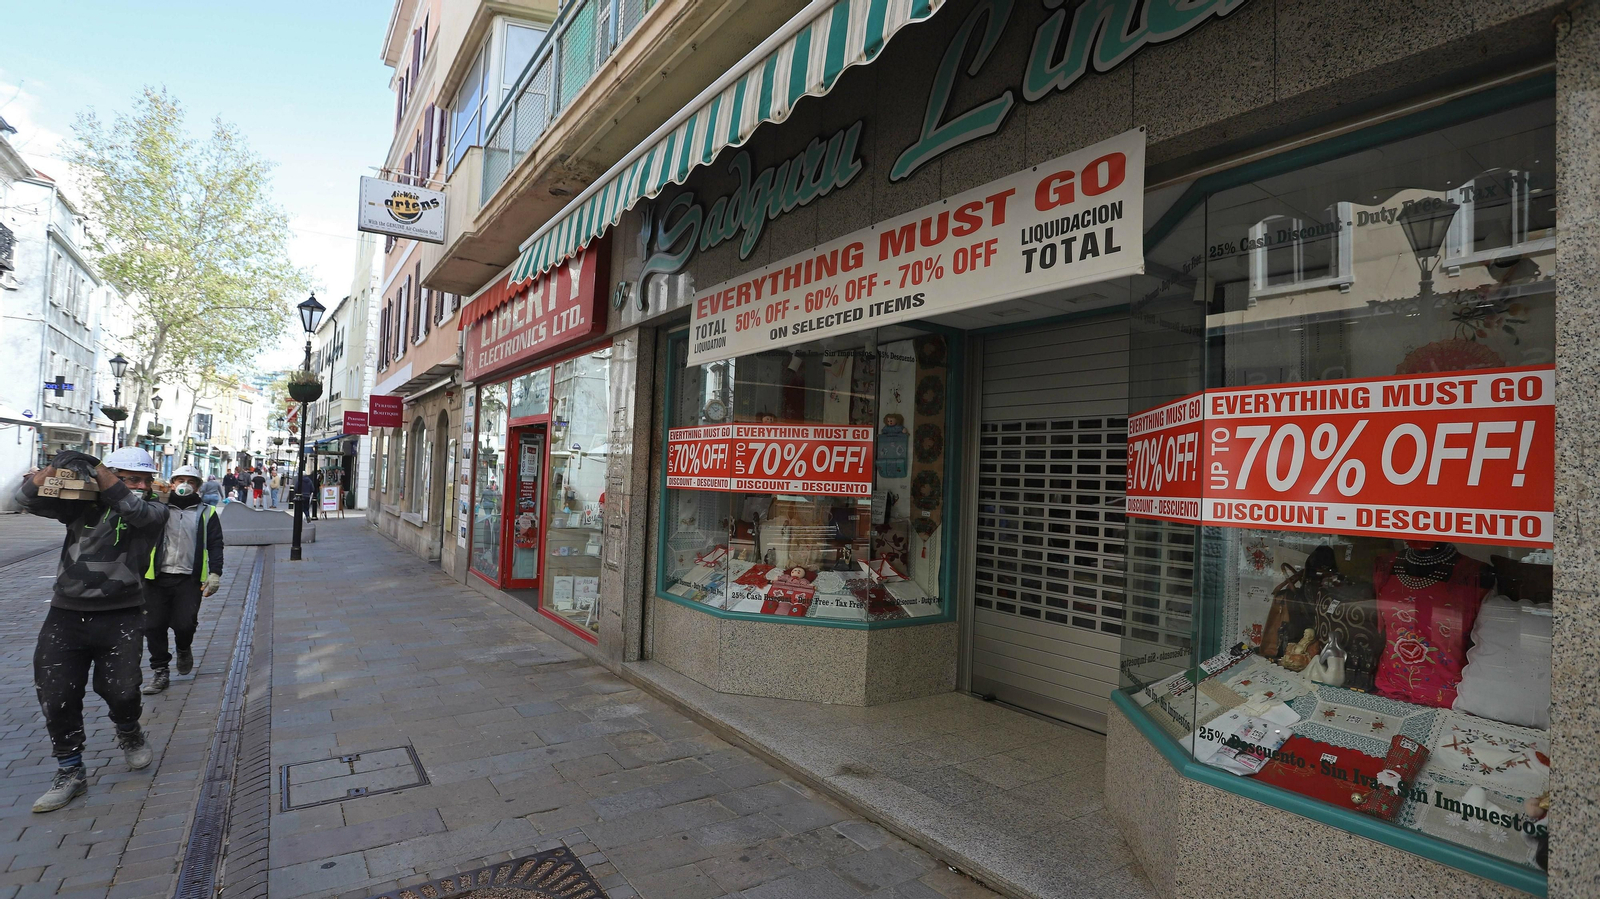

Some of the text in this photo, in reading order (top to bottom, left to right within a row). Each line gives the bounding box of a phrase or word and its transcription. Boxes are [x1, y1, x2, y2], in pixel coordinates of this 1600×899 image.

[391, 190, 420, 200] AirWair
[636, 120, 862, 310] Sadguru
[1021, 200, 1123, 246] LIQUIDACION
[1209, 242, 1236, 259] 25%
[1239, 234, 1273, 252] Cash
[1276, 219, 1343, 244] Discount
[1356, 205, 1397, 227] Duty
[1402, 195, 1443, 215] Free
[1459, 185, 1497, 204] Tax
[696, 151, 1126, 320] EVERYTHING MUST GO
[1021, 227, 1121, 274] TOTAL
[480, 252, 585, 348] LIBERTY
[735, 308, 761, 333] 50%
[765, 298, 790, 324] OFF
[804, 284, 839, 313] 60%
[844, 272, 877, 302] OFF
[898, 254, 944, 289] 70%
[952, 237, 998, 275] OFF
[695, 318, 727, 341] TOTAL
[769, 292, 926, 340] ON SELECTED ITEMS
[479, 304, 585, 369] ELECTRONICS LTD.
[694, 335, 727, 354] LIQUIDATION
[1212, 376, 1543, 415] EVERYTHING MUST GO
[669, 426, 731, 440] EVERYTHING MUST GO
[736, 427, 869, 440] EVERYTHING MUST GO
[1129, 399, 1200, 435] EVERYTHING MUST GO
[668, 446, 674, 473] UP TO
[673, 442, 729, 475] 70% OFF!
[735, 442, 746, 474] UP TO
[747, 442, 867, 478] 70% OFF!
[1127, 443, 1134, 490] UP TO
[1133, 431, 1199, 492] 70% OFF!
[1210, 427, 1230, 490] UP TO
[1235, 419, 1536, 497] 70% OFF!
[43, 487, 57, 495] C24
[49, 478, 63, 486] C24
[668, 478, 692, 486] DISCOUNT
[697, 478, 728, 488] DESCUENTO
[737, 480, 791, 491] DISCOUNT
[802, 482, 867, 493] DESCUENTO
[1128, 499, 1153, 514] DISCOUNT
[1158, 499, 1198, 518] DESCUENTO
[1213, 502, 1328, 525] DISCOUNT
[1356, 508, 1542, 538] DESCUENTO
[746, 592, 762, 601] Cash
[814, 598, 829, 606] Free
[835, 599, 848, 608] Tax
[848, 600, 864, 609] Free
[1199, 726, 1228, 746] 25%
[1230, 733, 1306, 769] Descuento
[1320, 759, 1349, 781] Sin
[1353, 768, 1378, 790] Iva
[1397, 779, 1429, 805] Sin
[1434, 790, 1548, 837] Impuestos
